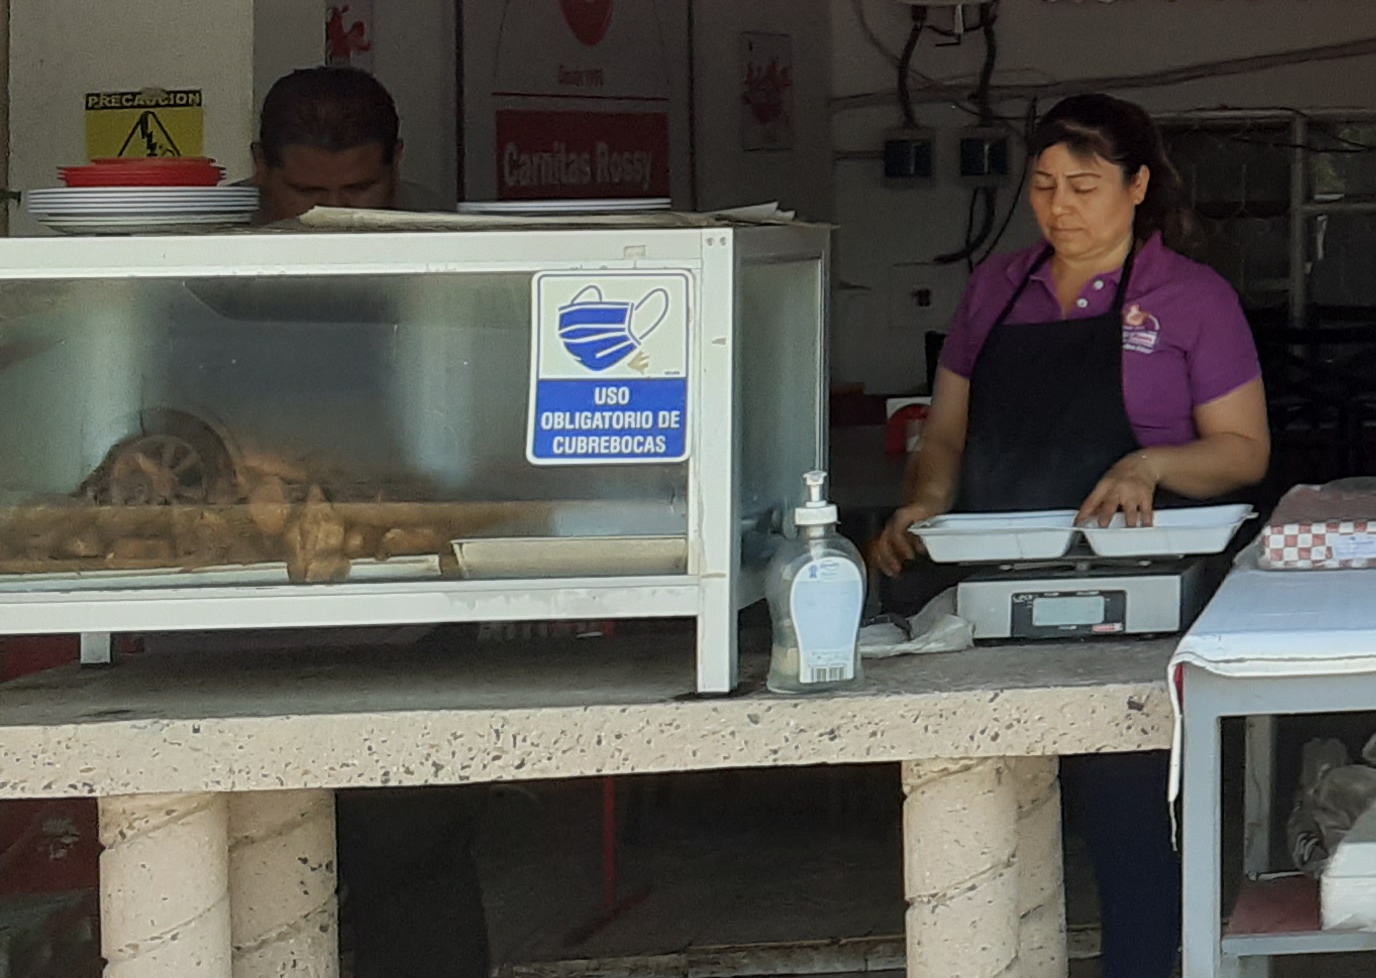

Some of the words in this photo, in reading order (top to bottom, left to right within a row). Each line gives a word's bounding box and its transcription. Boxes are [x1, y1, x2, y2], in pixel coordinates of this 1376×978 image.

[593, 386, 631, 406] USO
[540, 410, 654, 430] OBLIGATORIO
[657, 409, 681, 429] DE
[551, 434, 667, 455] CUBREBOCAS
